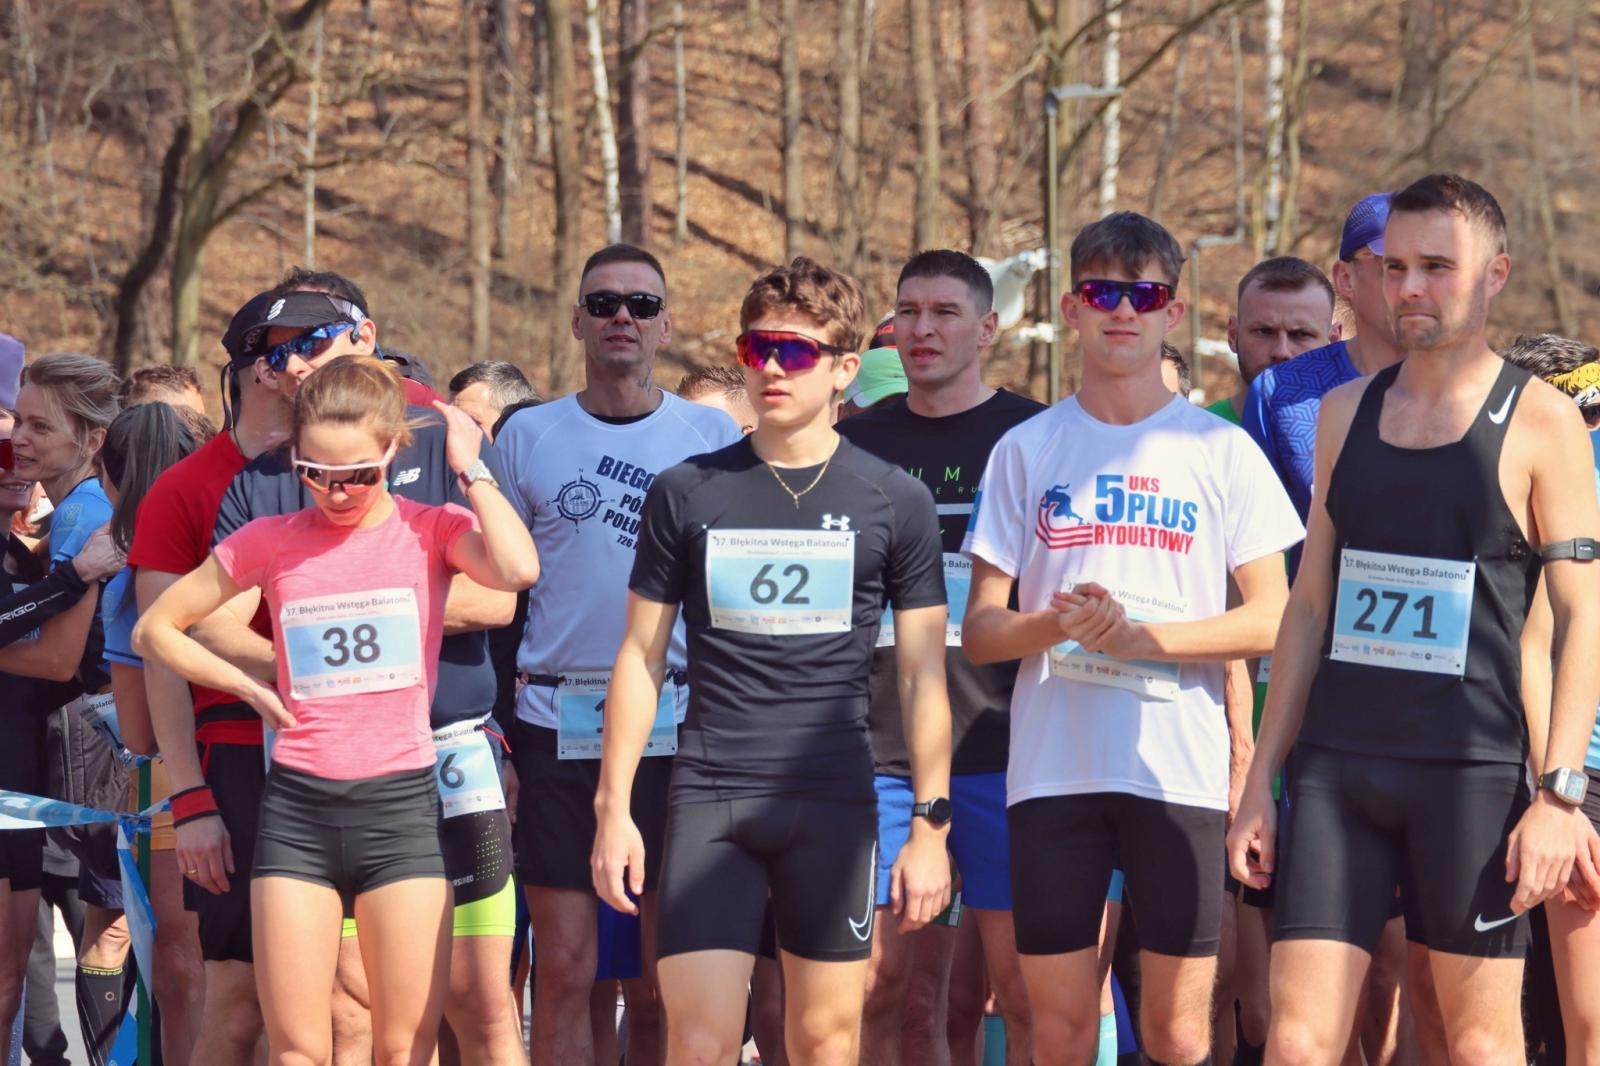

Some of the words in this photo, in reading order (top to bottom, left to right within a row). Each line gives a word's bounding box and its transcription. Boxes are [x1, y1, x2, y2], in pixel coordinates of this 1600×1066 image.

[1129, 475, 1161, 493] UKS
[1095, 474, 1125, 523] 5
[1127, 493, 1198, 533] PLUS
[616, 534, 634, 549] 726
[715, 538, 729, 547] 17.
[730, 537, 768, 547] Błękitna
[771, 538, 805, 548] Wstęga
[1094, 523, 1194, 555] RYDUŁTOWY
[1345, 558, 1355, 568] 17.
[1356, 560, 1387, 573] Błękitna
[1387, 564, 1421, 577] Wstęga
[1423, 568, 1467, 581] Balatonu
[750, 563, 810, 605] 62
[299, 603, 336, 615] Błękitna
[337, 600, 370, 611] Wstęga
[1353, 587, 1437, 640] 271
[322, 623, 381, 667] 38
[575, 677, 608, 687] Błękitna
[440, 752, 465, 789] 6
